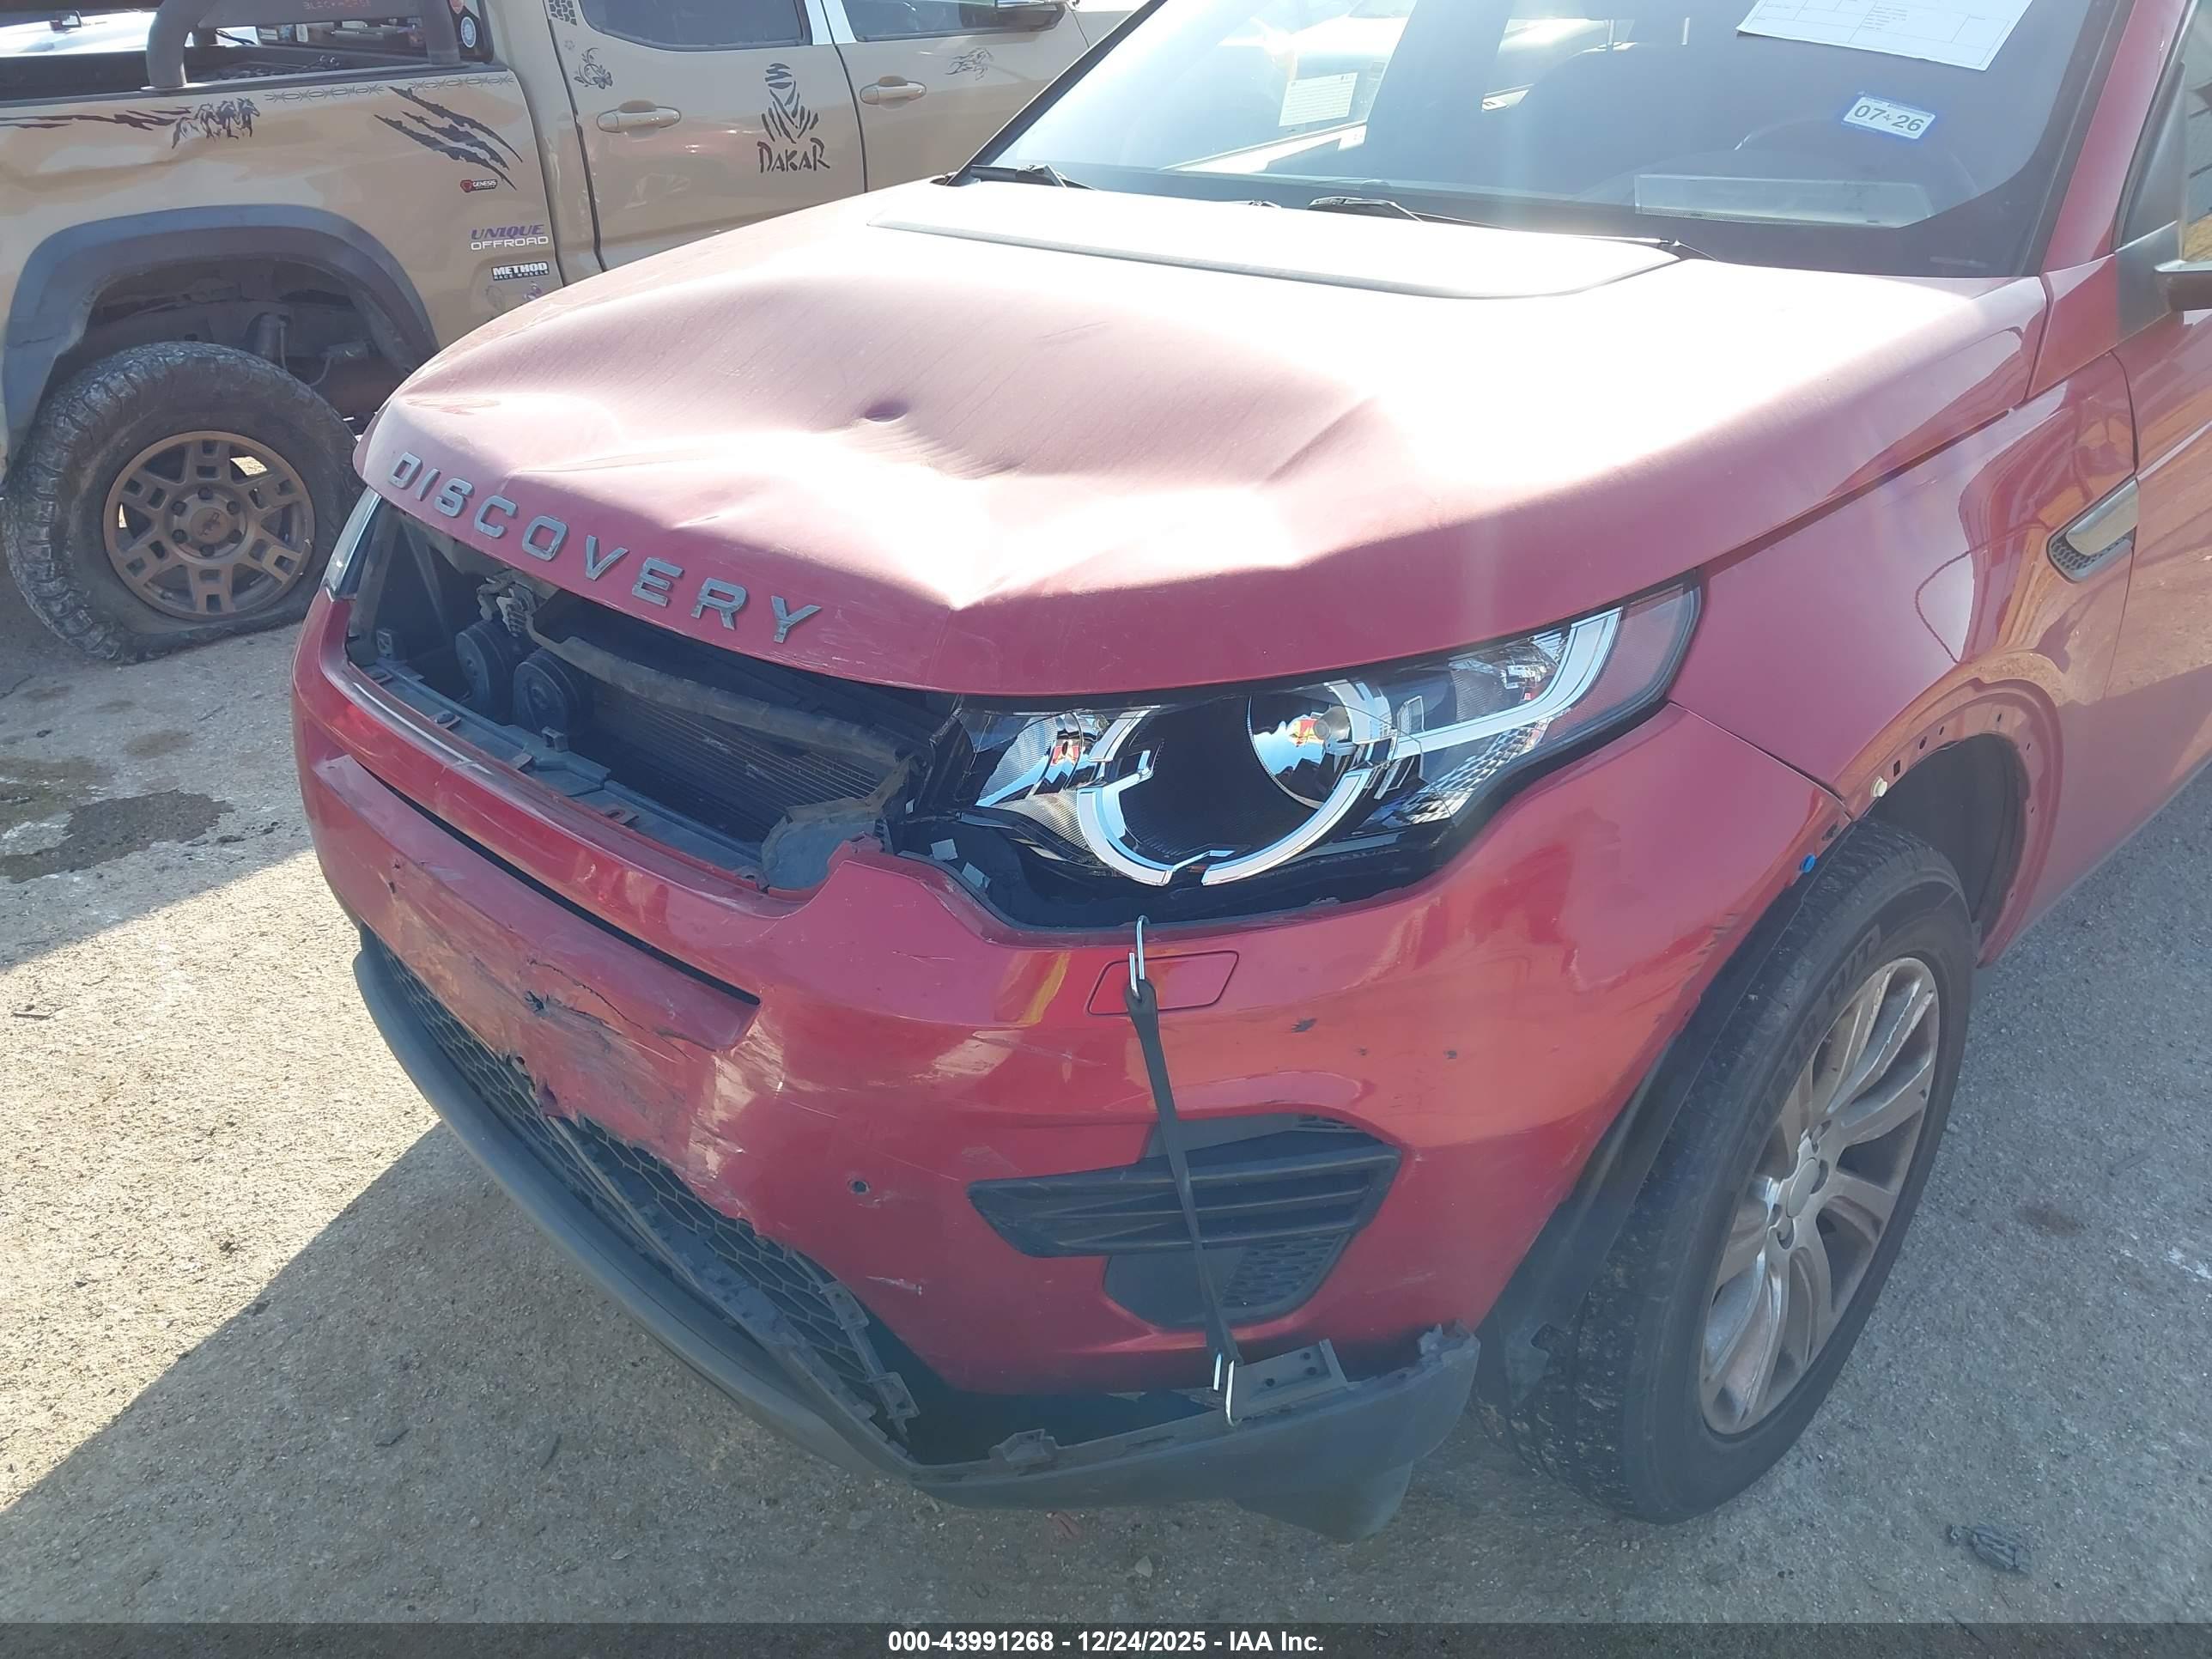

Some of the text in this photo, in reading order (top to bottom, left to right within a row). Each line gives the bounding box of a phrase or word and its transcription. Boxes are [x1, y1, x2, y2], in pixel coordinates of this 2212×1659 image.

[1854, 105, 1887, 120] 07
[1891, 114, 1924, 131] 26
[757, 137, 830, 173] DAKAR
[471, 224, 544, 240] UNIQUE
[471, 236, 549, 251] OFFROAD
[492, 262, 548, 276] METHOD
[387, 452, 822, 643] DISCOVERY
